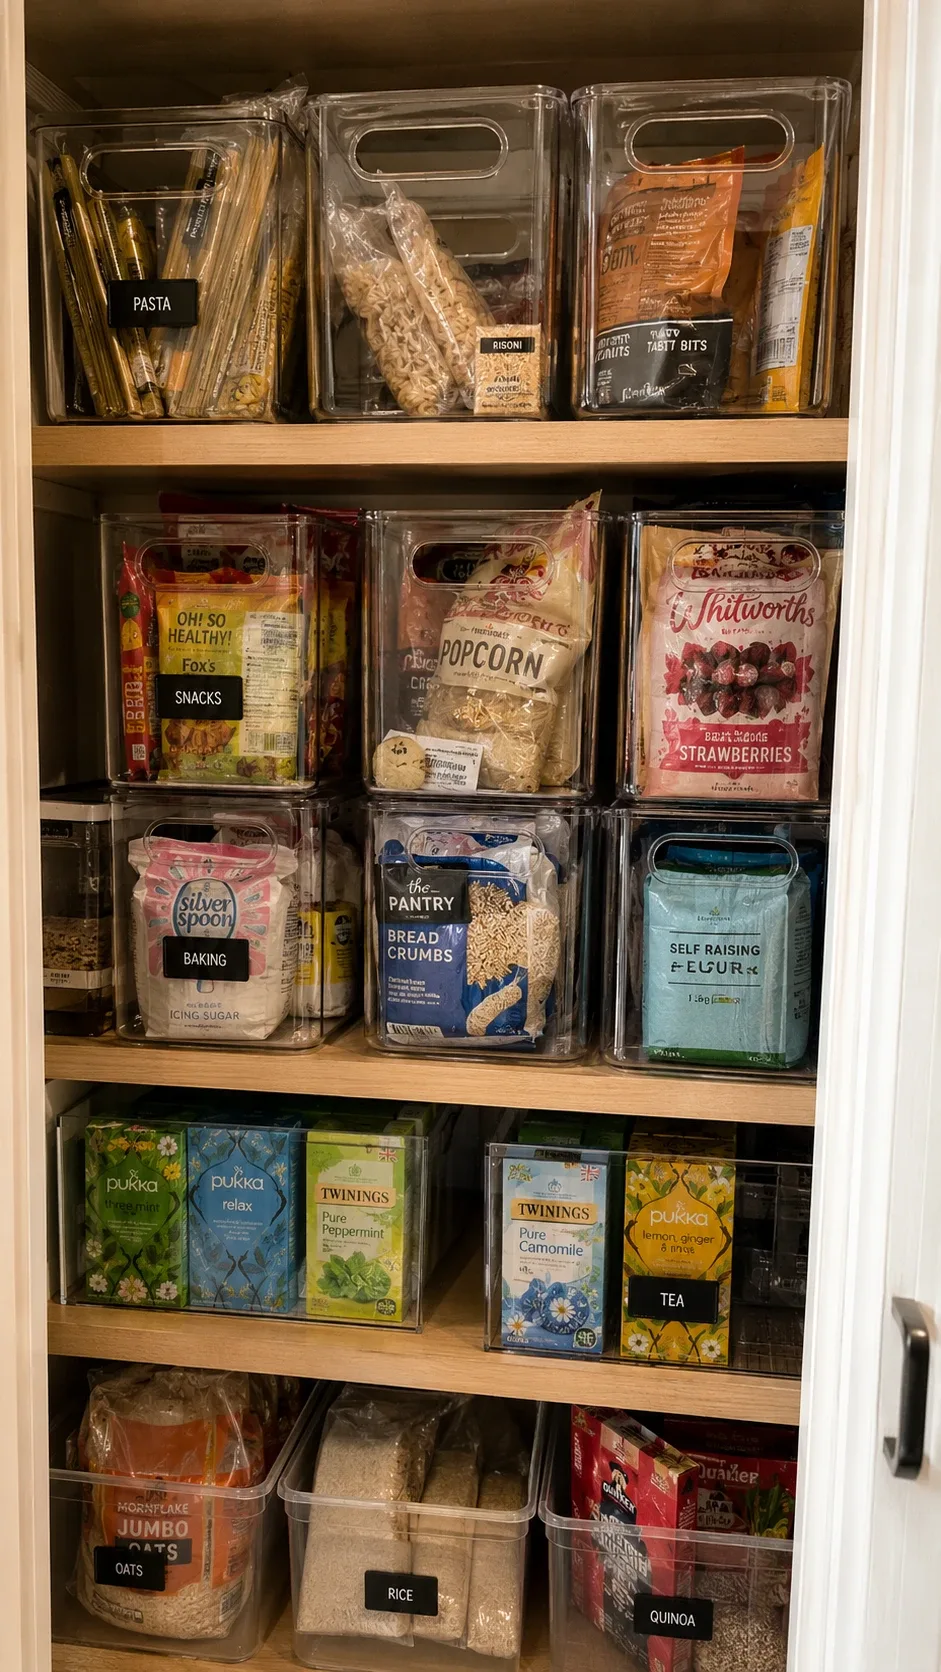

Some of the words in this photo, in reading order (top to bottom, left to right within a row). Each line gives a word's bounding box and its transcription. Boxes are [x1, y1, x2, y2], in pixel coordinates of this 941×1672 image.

[133, 296, 171, 311] PASTA
[493, 341, 522, 350] RISONI
[681, 340, 707, 351] BITS
[666, 587, 815, 634] Whitworths
[177, 612, 203, 626] OH!
[207, 613, 226, 627] SO
[168, 629, 232, 647] HEALTHY!
[182, 658, 216, 673] Fox's
[440, 639, 543, 680] POPCORN
[175, 691, 222, 705] SNACKS
[680, 746, 792, 764] STRAWBERRIES
[407, 877, 430, 895] the
[178, 894, 231, 913] silver
[389, 896, 454, 911] PANTRY
[177, 911, 234, 934] spoon
[387, 929, 439, 945] BREAD
[387, 946, 453, 962] CRUMBS
[670, 943, 700, 955] SELF
[705, 944, 760, 956] RAISING
[183, 952, 227, 967] BAKING
[170, 1010, 199, 1020] ICING
[203, 1011, 240, 1020] SUGAR
[107, 1173, 158, 1193] pukka
[212, 1171, 264, 1191] pukka
[321, 1187, 389, 1204] TWININGS
[222, 1198, 252, 1212] relax
[518, 1203, 590, 1220] TWININGS
[322, 1211, 347, 1224] Pure
[650, 1209, 708, 1226] pukka
[322, 1224, 385, 1240] Peppermint
[519, 1227, 546, 1240] Pure
[680, 1234, 715, 1245] ginger
[519, 1240, 583, 1257] Camomile
[660, 1293, 685, 1308] TEA
[117, 1502, 189, 1514] MORNFLAKE
[117, 1519, 189, 1538] JUMBO
[115, 1562, 143, 1577] OATS
[388, 1588, 413, 1602] RICE
[650, 1610, 696, 1627] QUINOA
